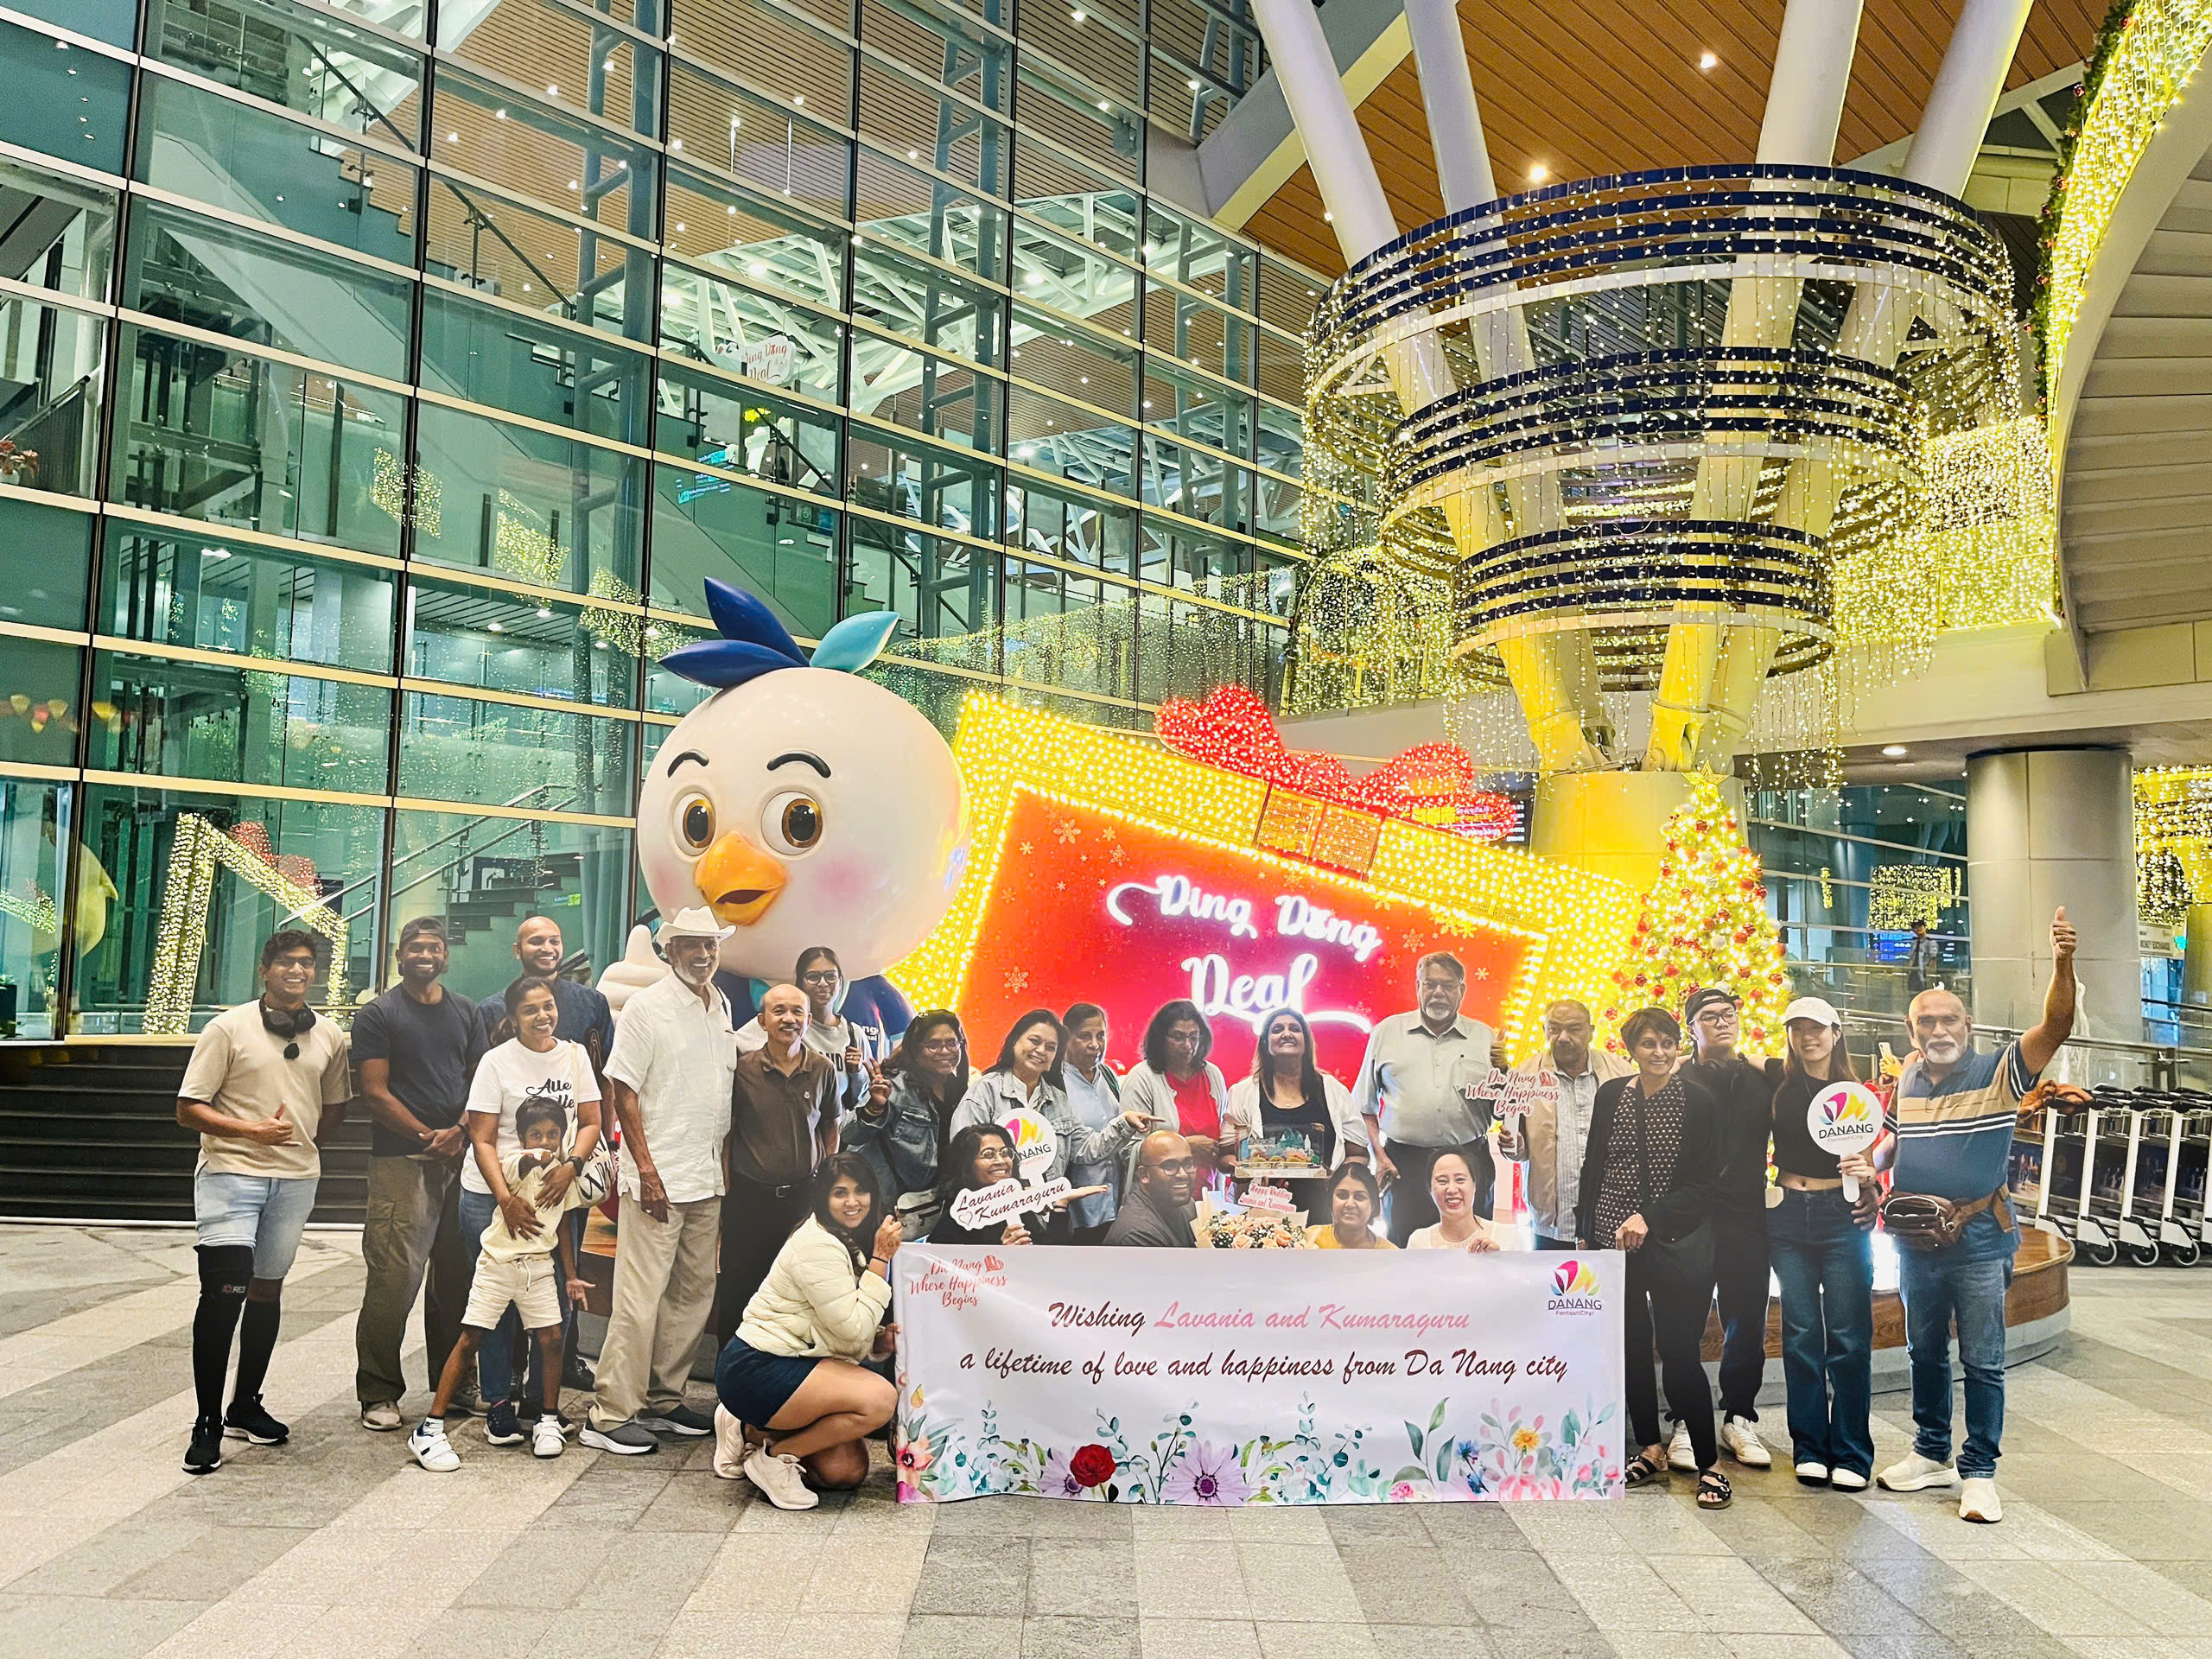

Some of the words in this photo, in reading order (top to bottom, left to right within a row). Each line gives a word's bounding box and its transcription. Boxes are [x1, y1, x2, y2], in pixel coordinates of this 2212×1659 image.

[1106, 875, 1258, 939] Ding
[1181, 953, 1372, 1035] Deal
[1487, 1071, 1504, 1084] Da
[1509, 1071, 1536, 1089] Nang
[1466, 1080, 1501, 1097] Where
[1504, 1085, 1560, 1103] Happiness
[1496, 1099, 1531, 1118] Begins
[1818, 1123, 1874, 1140] DANANG
[1018, 1143, 1052, 1160] NANG
[957, 1183, 1016, 1212] Lavania
[975, 1183, 1065, 1223] Kumaraguru
[952, 1258, 983, 1276] Nang
[910, 1273, 945, 1295] Where
[949, 1274, 1007, 1294] Happiness
[941, 1291, 979, 1311] Begins
[1548, 1298, 1603, 1311] DANANG
[1048, 1300, 1146, 1338] Wishing
[1154, 1300, 1255, 1329] Lavania
[1265, 1306, 1312, 1329] and
[1319, 1303, 1471, 1338] Kumaraguru
[960, 1353, 976, 1370] a
[984, 1347, 1073, 1379] lifetime
[1082, 1351, 1106, 1385] of
[1114, 1351, 1159, 1376] love
[1167, 1351, 1213, 1376] and
[1221, 1349, 1335, 1383] happiness
[1342, 1351, 1397, 1385] from
[1404, 1349, 1446, 1376] Da
[1452, 1348, 1517, 1384] Nang
[1526, 1355, 1568, 1383] city
